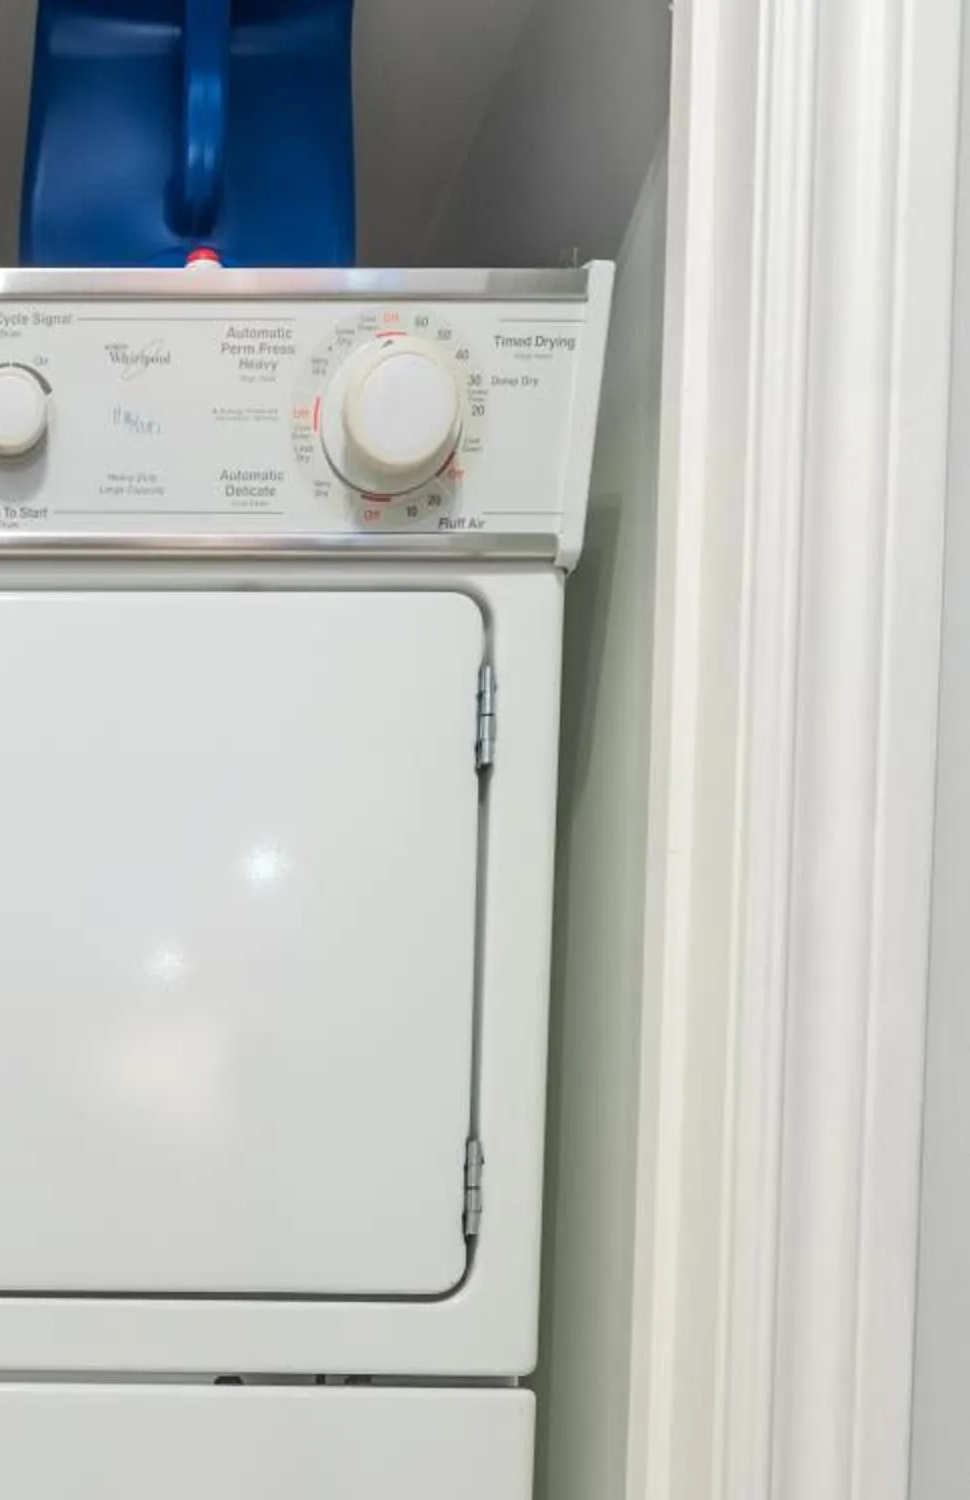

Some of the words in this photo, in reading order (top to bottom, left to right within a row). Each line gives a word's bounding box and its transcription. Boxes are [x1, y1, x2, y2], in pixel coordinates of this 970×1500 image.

[32, 313, 72, 327] Signal
[225, 326, 293, 339] Automatic
[437, 329, 451, 341] 50
[221, 342, 255, 355] Perm
[259, 342, 295, 355] Press
[493, 335, 533, 348] Timed
[534, 335, 577, 351] Drying
[107, 348, 172, 367] Whirlpool
[454, 348, 470, 360] 40
[237, 358, 279, 372] Heavy
[467, 374, 482, 386] 30
[521, 375, 540, 388] Dry
[471, 405, 486, 416] 20
[219, 468, 285, 482] Automatic
[225, 484, 277, 498] Delicate
[4, 506, 17, 518] To
[20, 506, 48, 519] Start
[438, 517, 466, 530] Fluff
[468, 517, 486, 529] Air
